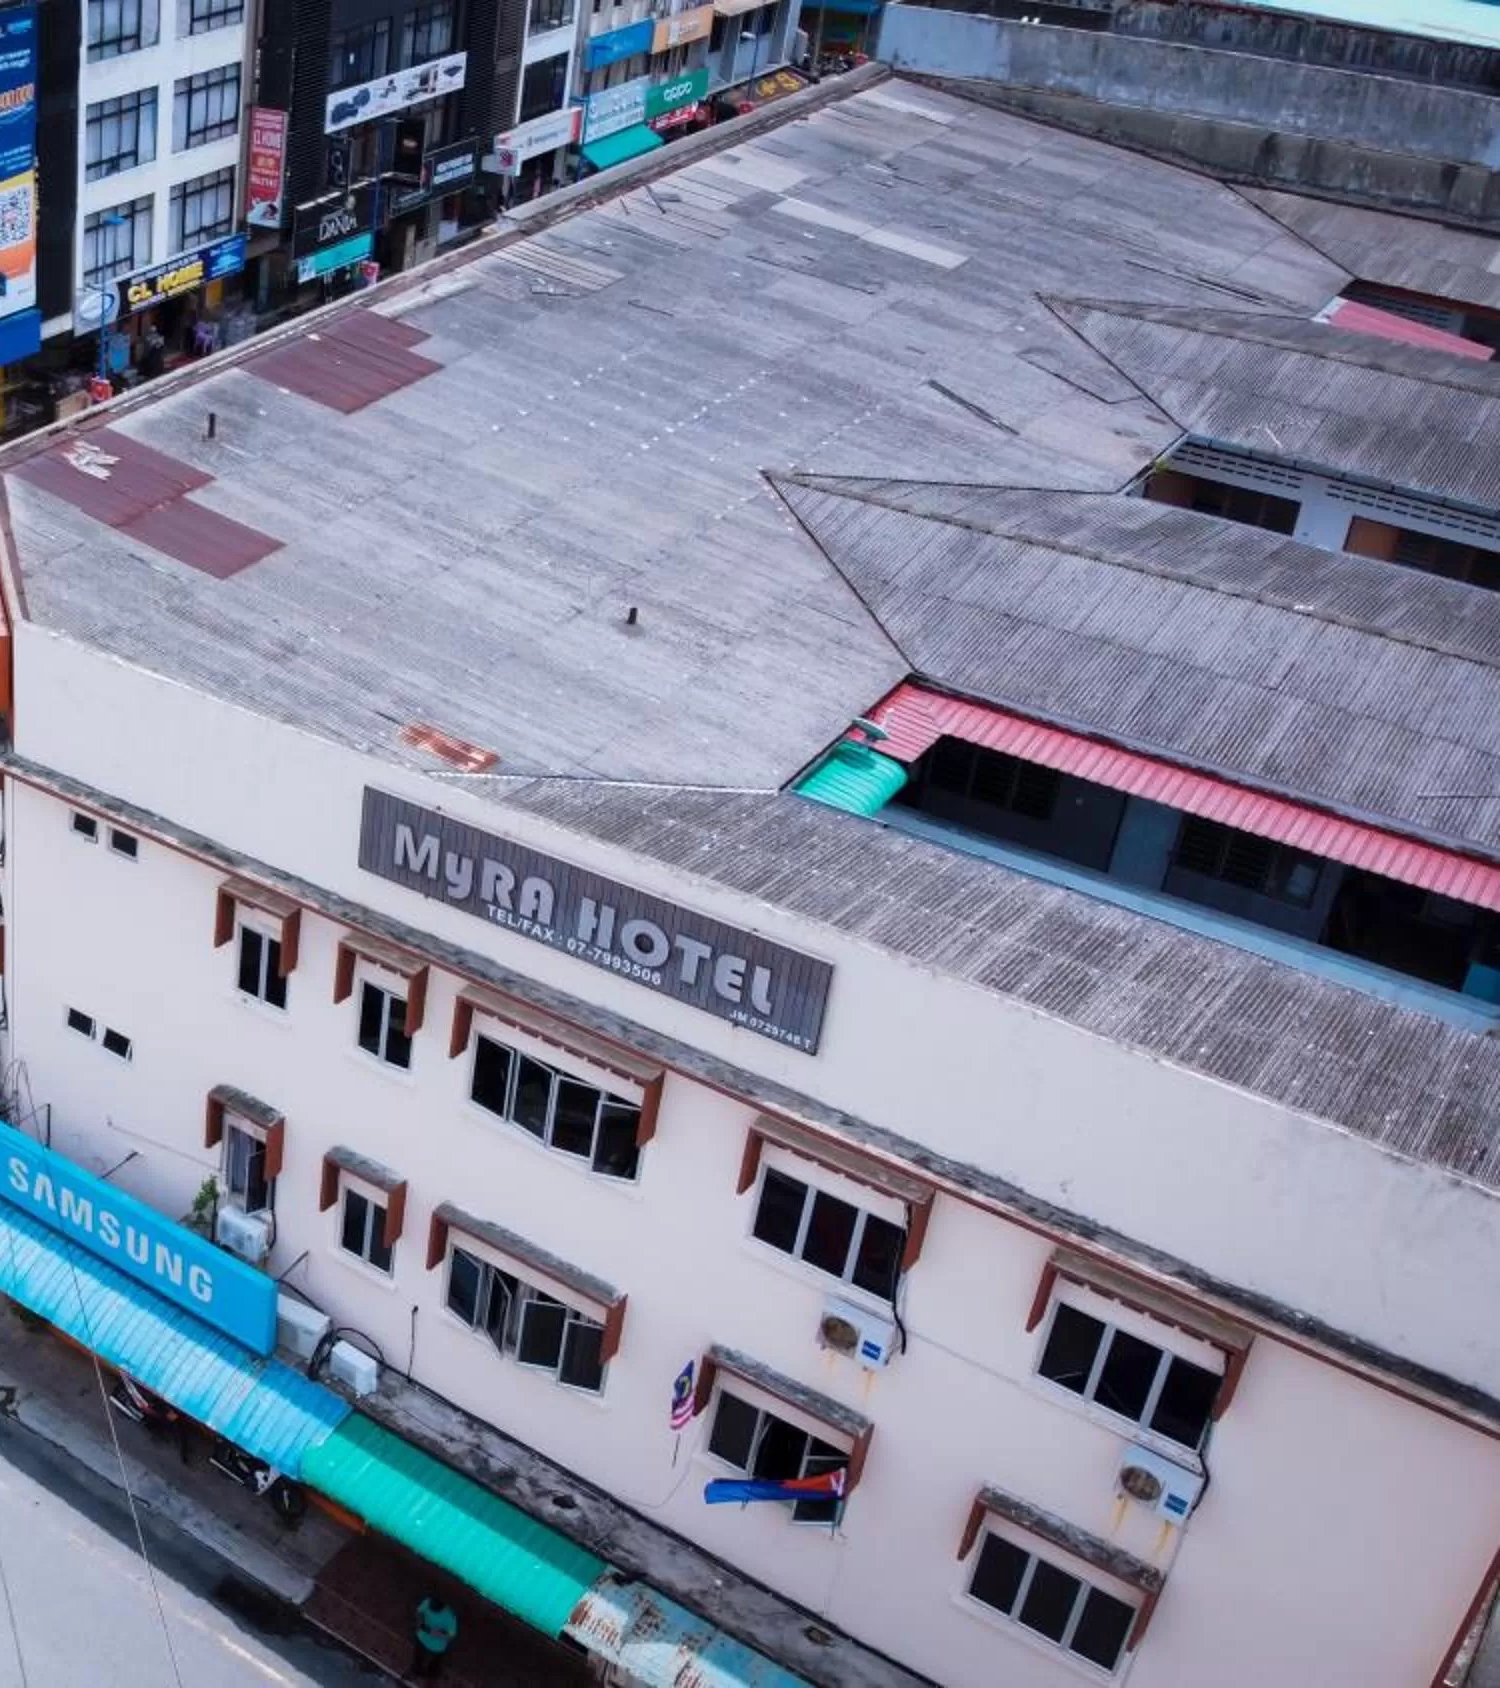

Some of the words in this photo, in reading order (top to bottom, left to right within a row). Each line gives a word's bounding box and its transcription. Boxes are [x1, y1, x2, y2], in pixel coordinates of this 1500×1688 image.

[567, 937, 662, 985] 07-7993506
[578, 897, 772, 1016] HOTEL
[8, 1156, 214, 1304] SAMSUNG
